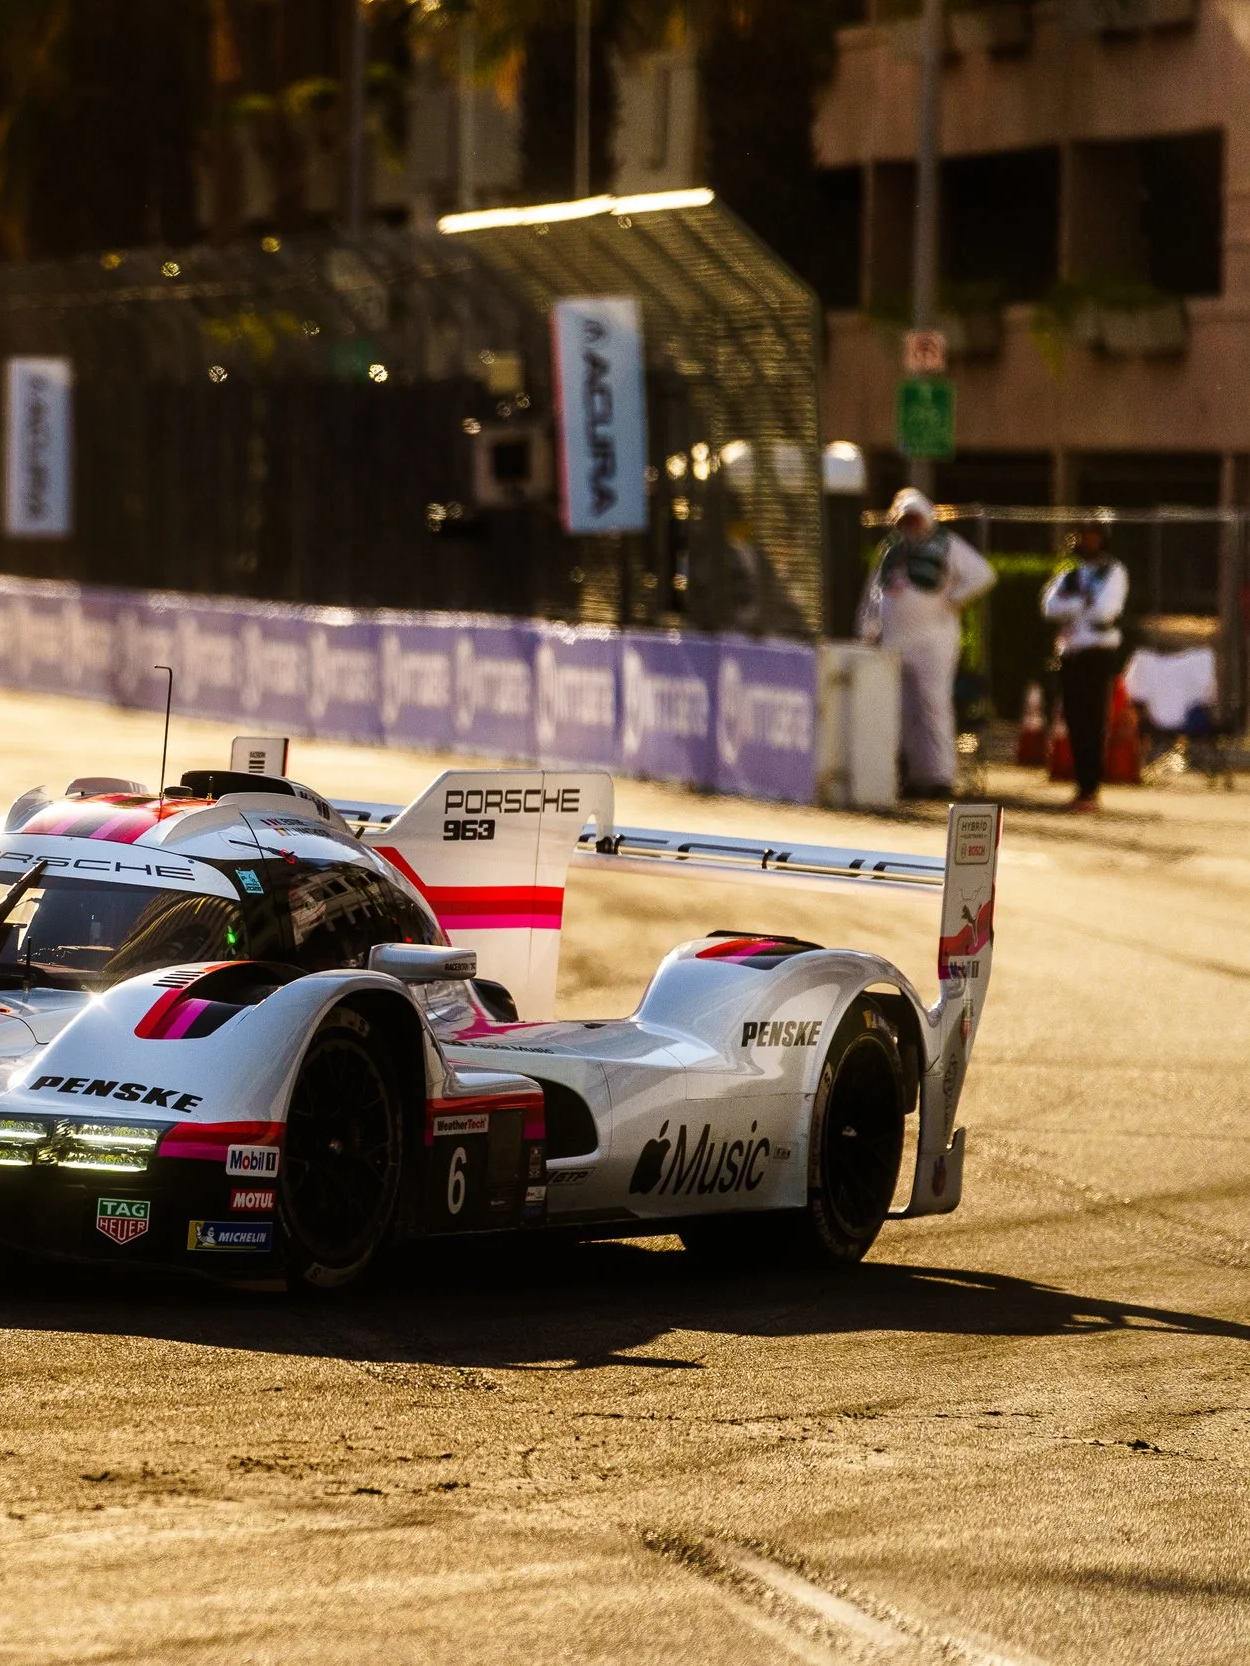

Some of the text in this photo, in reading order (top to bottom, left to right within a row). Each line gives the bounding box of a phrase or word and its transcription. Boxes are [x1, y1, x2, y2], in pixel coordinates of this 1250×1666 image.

[581, 350, 617, 518] ACURA
[444, 788, 580, 814] PORSCHE
[443, 819, 496, 841] 963
[961, 821, 988, 831] HYBRID
[741, 1020, 823, 1047] PENSKE
[28, 1075, 204, 1113] PENSKE
[436, 1117, 486, 1131] WeatherTech
[230, 1150, 277, 1171] Mobil 1
[658, 1119, 770, 1195] Music
[448, 1147, 467, 1215] 6
[102, 1201, 145, 1217] TAG
[232, 1192, 274, 1209] MOTUL
[100, 1218, 146, 1241] HEUER
[217, 1232, 267, 1243] MICHELIN
